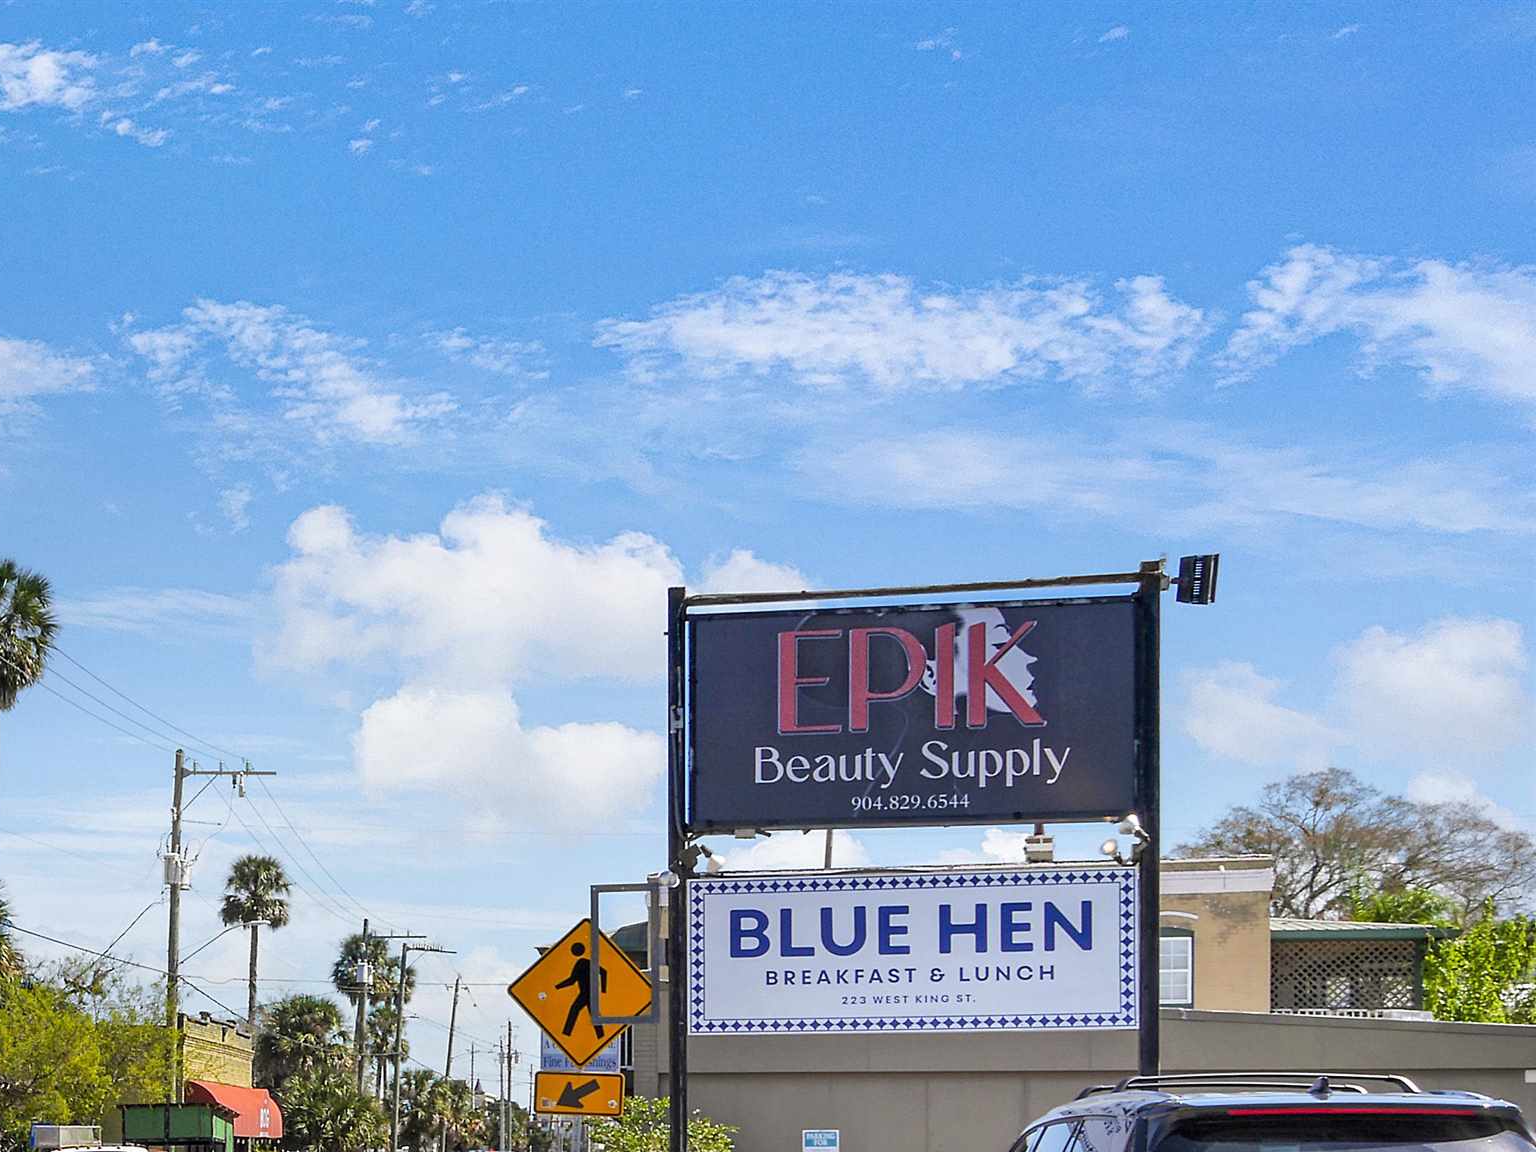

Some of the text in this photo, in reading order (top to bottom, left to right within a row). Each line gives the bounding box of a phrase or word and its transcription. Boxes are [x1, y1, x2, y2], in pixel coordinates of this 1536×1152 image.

[777, 620, 1048, 736] EPIK
[753, 738, 1071, 789] Beauty Supply
[850, 794, 971, 812] 904.829.6544
[729, 900, 1094, 958] BLUE HEN
[765, 965, 1056, 986] BREAKFAST & LUNCH
[841, 993, 977, 1005] 223 WEST KING ST.
